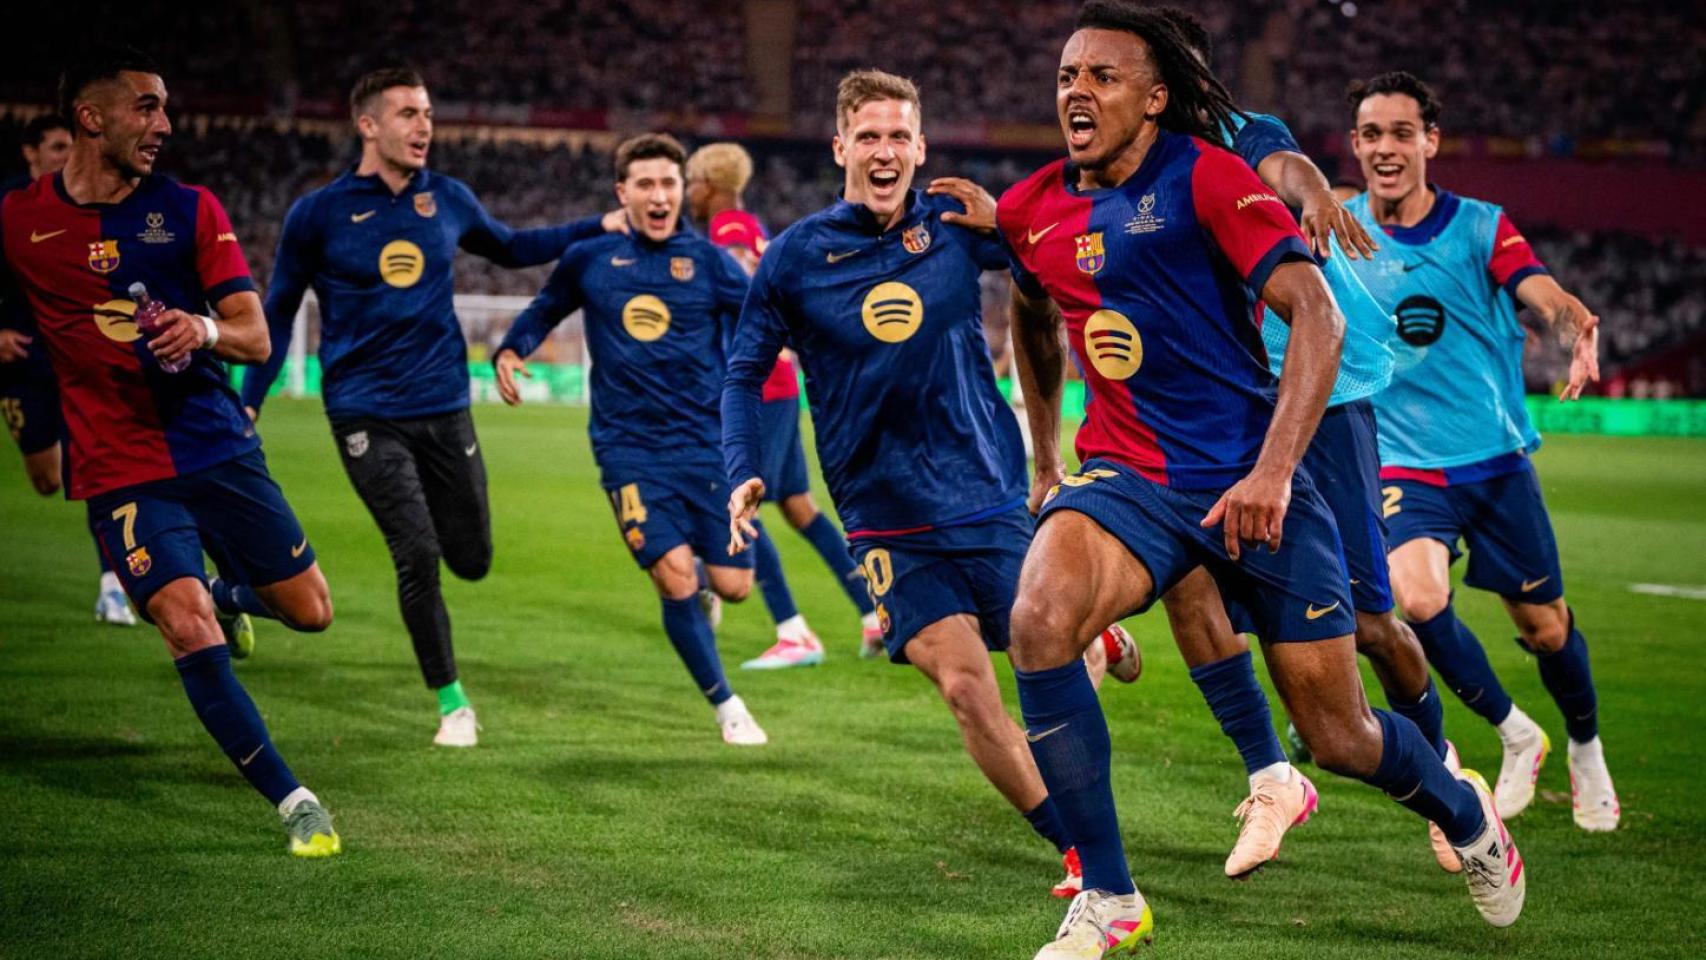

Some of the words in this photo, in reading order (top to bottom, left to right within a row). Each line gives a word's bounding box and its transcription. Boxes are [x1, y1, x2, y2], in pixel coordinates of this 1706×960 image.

[611, 484, 648, 525] 4
[1381, 486, 1403, 519] 2
[111, 501, 138, 551] 7
